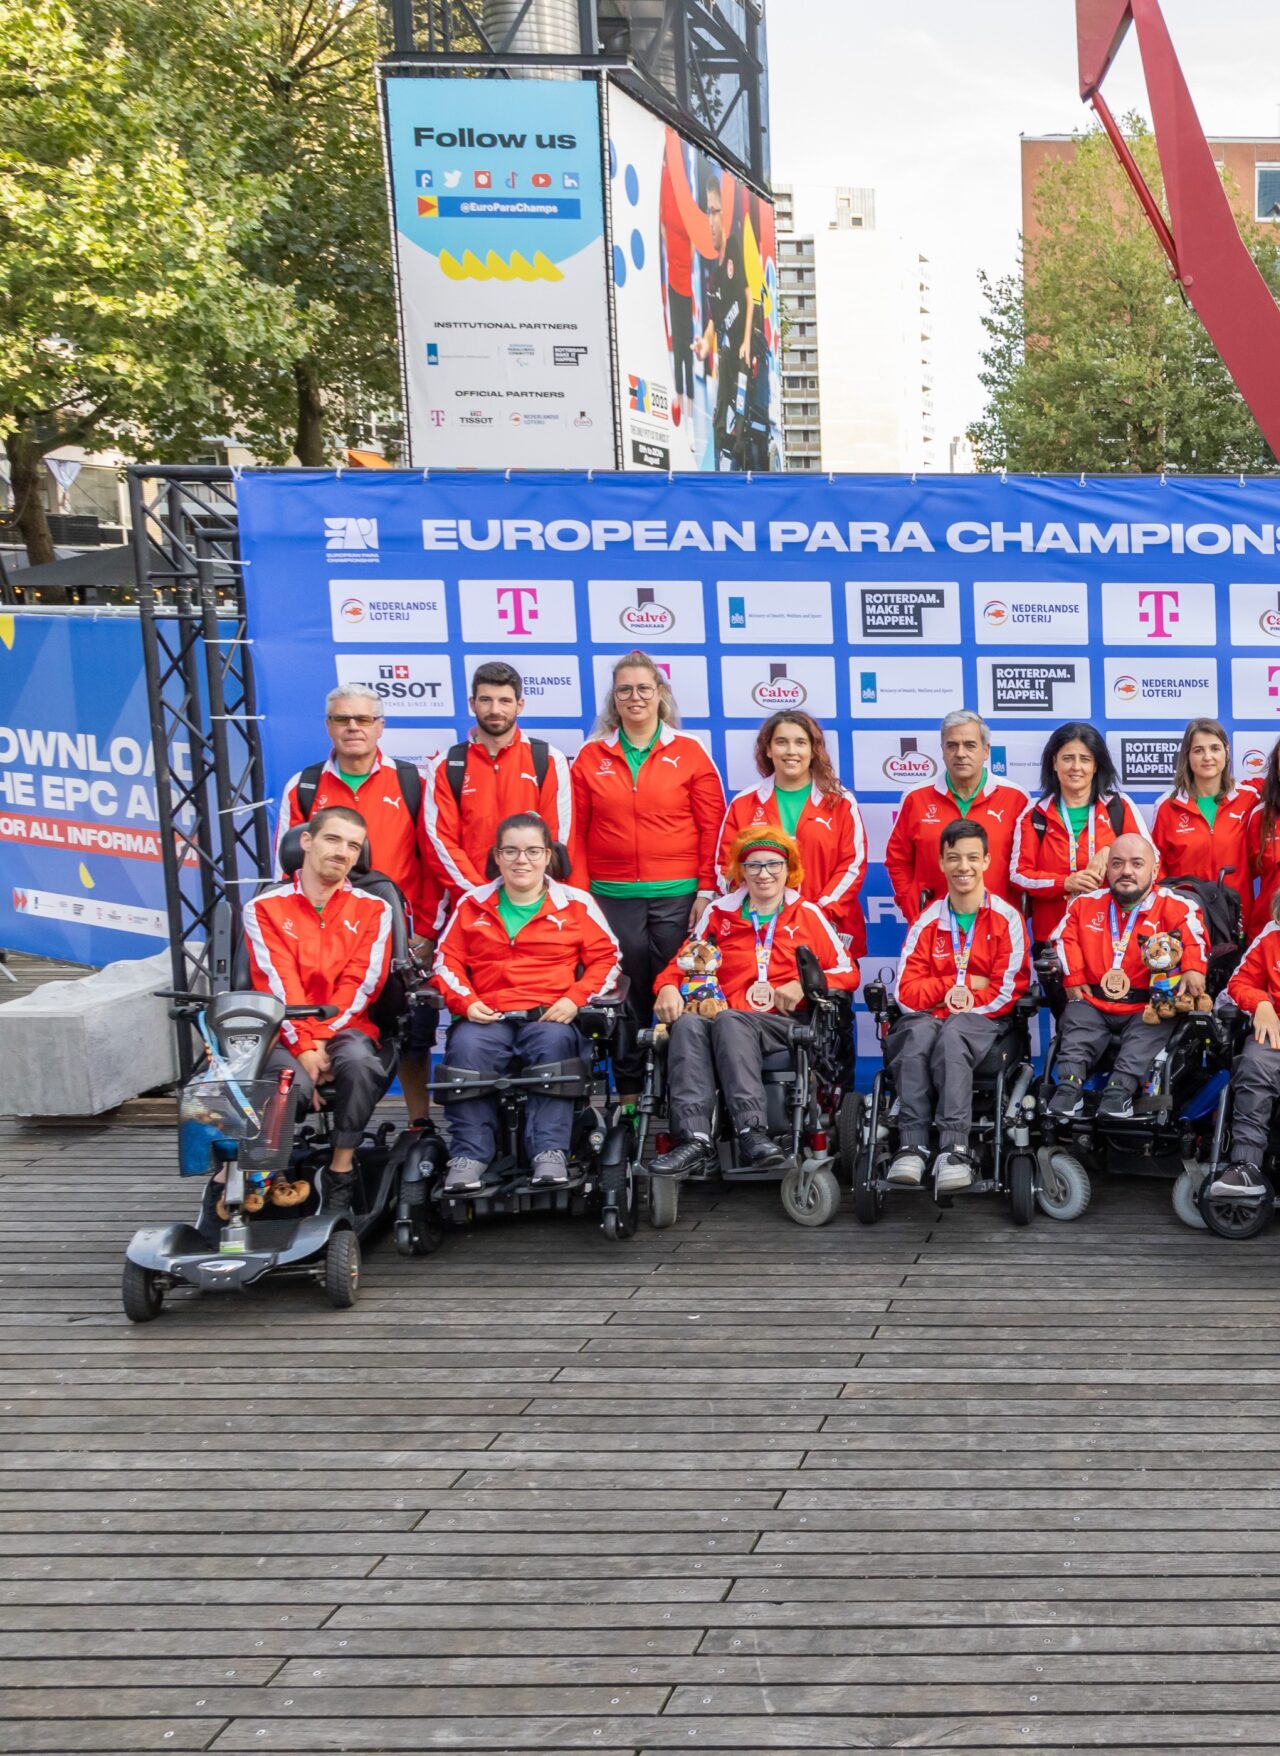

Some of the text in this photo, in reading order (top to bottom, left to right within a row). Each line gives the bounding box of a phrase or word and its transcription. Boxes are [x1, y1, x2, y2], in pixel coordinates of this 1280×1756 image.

[414, 127, 577, 150] Follow us
[460, 201, 558, 214] @EuroParaChamps
[434, 321, 578, 331] INSTITUTIONAL PARTNERS
[455, 390, 565, 399] OFFICIAL PARTNERS
[422, 519, 757, 552] EUROPEAN
[769, 520, 935, 554] PARA
[865, 593, 940, 604] ROTTERDAM.
[369, 601, 438, 611] NEDERLANDSE
[866, 605, 915, 615] MAKE IT
[1012, 604, 1080, 613] NEDERLANDSE
[370, 611, 410, 621] LOTERIJ
[497, 588, 539, 635] T
[1138, 591, 1179, 638] T
[626, 611, 667, 623] Calvé
[866, 616, 918, 626] HAPPEN.
[1012, 614, 1052, 623] LOTERIJ
[996, 668, 1070, 679] ROTTERDAM.
[523, 676, 572, 686] ERLANDSE
[997, 679, 1046, 689] MAKE IT
[1142, 679, 1209, 688] NEDERLANDSE
[524, 686, 544, 695] ERIJ
[758, 687, 799, 698] Calvé
[997, 690, 1048, 700] HAPPEN.
[1142, 689, 1182, 698] LOTERIJ
[1126, 743, 1182, 753] ROTTERDA
[1126, 753, 1174, 763] MAKE IT
[889, 760, 930, 771] Calvé
[1126, 764, 1177, 774] HAPPEN.
[42, 775, 118, 816] EPC
[30, 821, 64, 843] ALL
